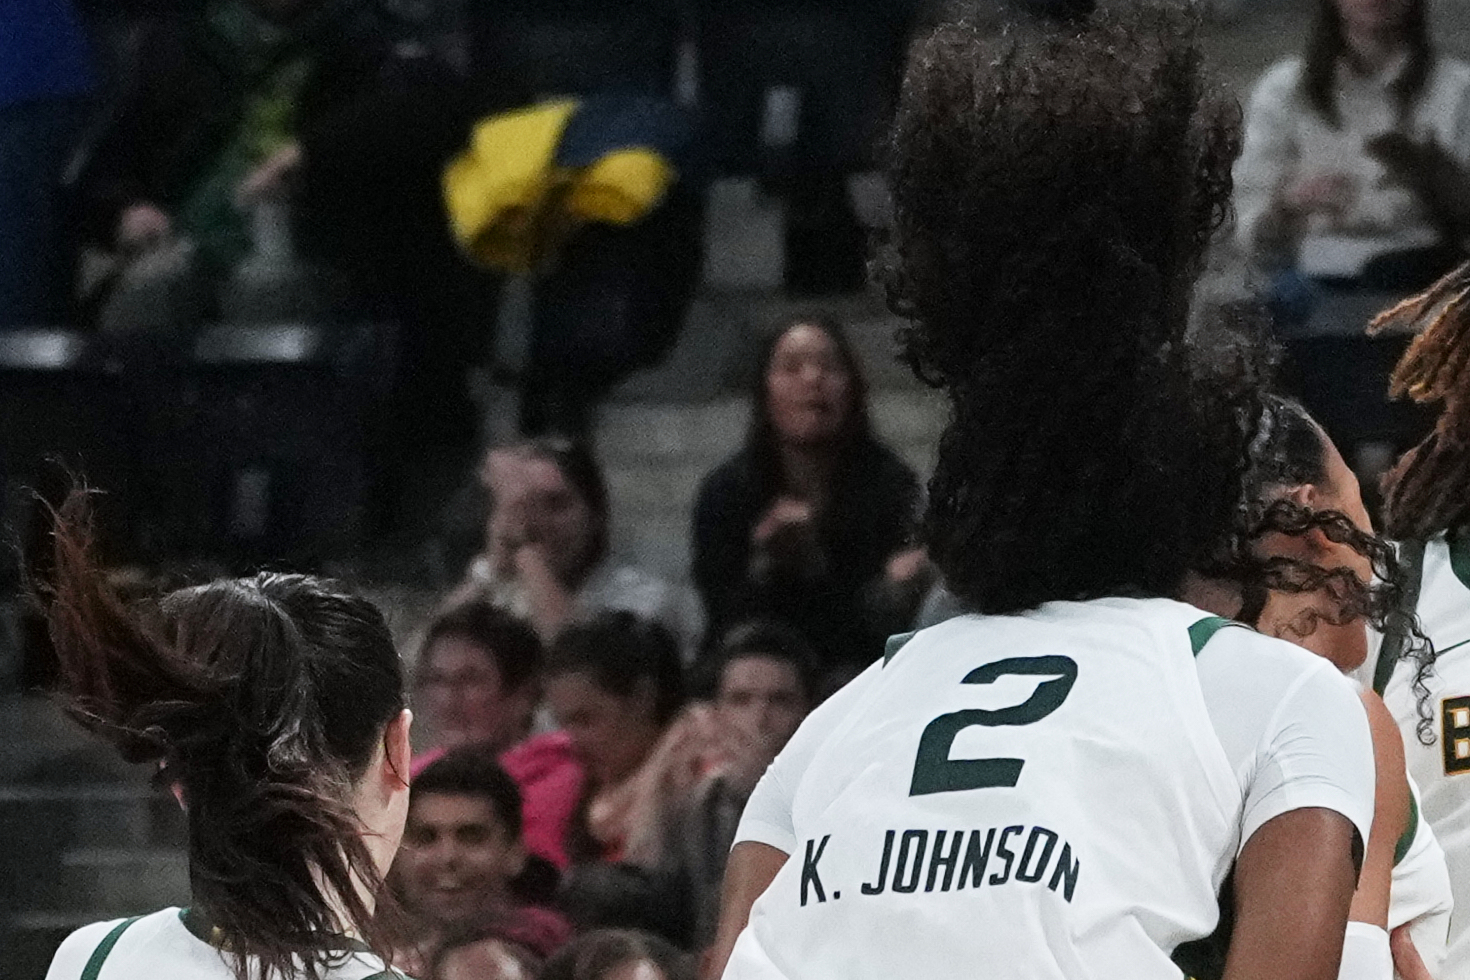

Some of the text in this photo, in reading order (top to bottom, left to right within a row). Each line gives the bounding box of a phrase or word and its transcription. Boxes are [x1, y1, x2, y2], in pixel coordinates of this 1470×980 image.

[908, 654, 1079, 798] 2
[799, 824, 1080, 907] K. JOHNSON
